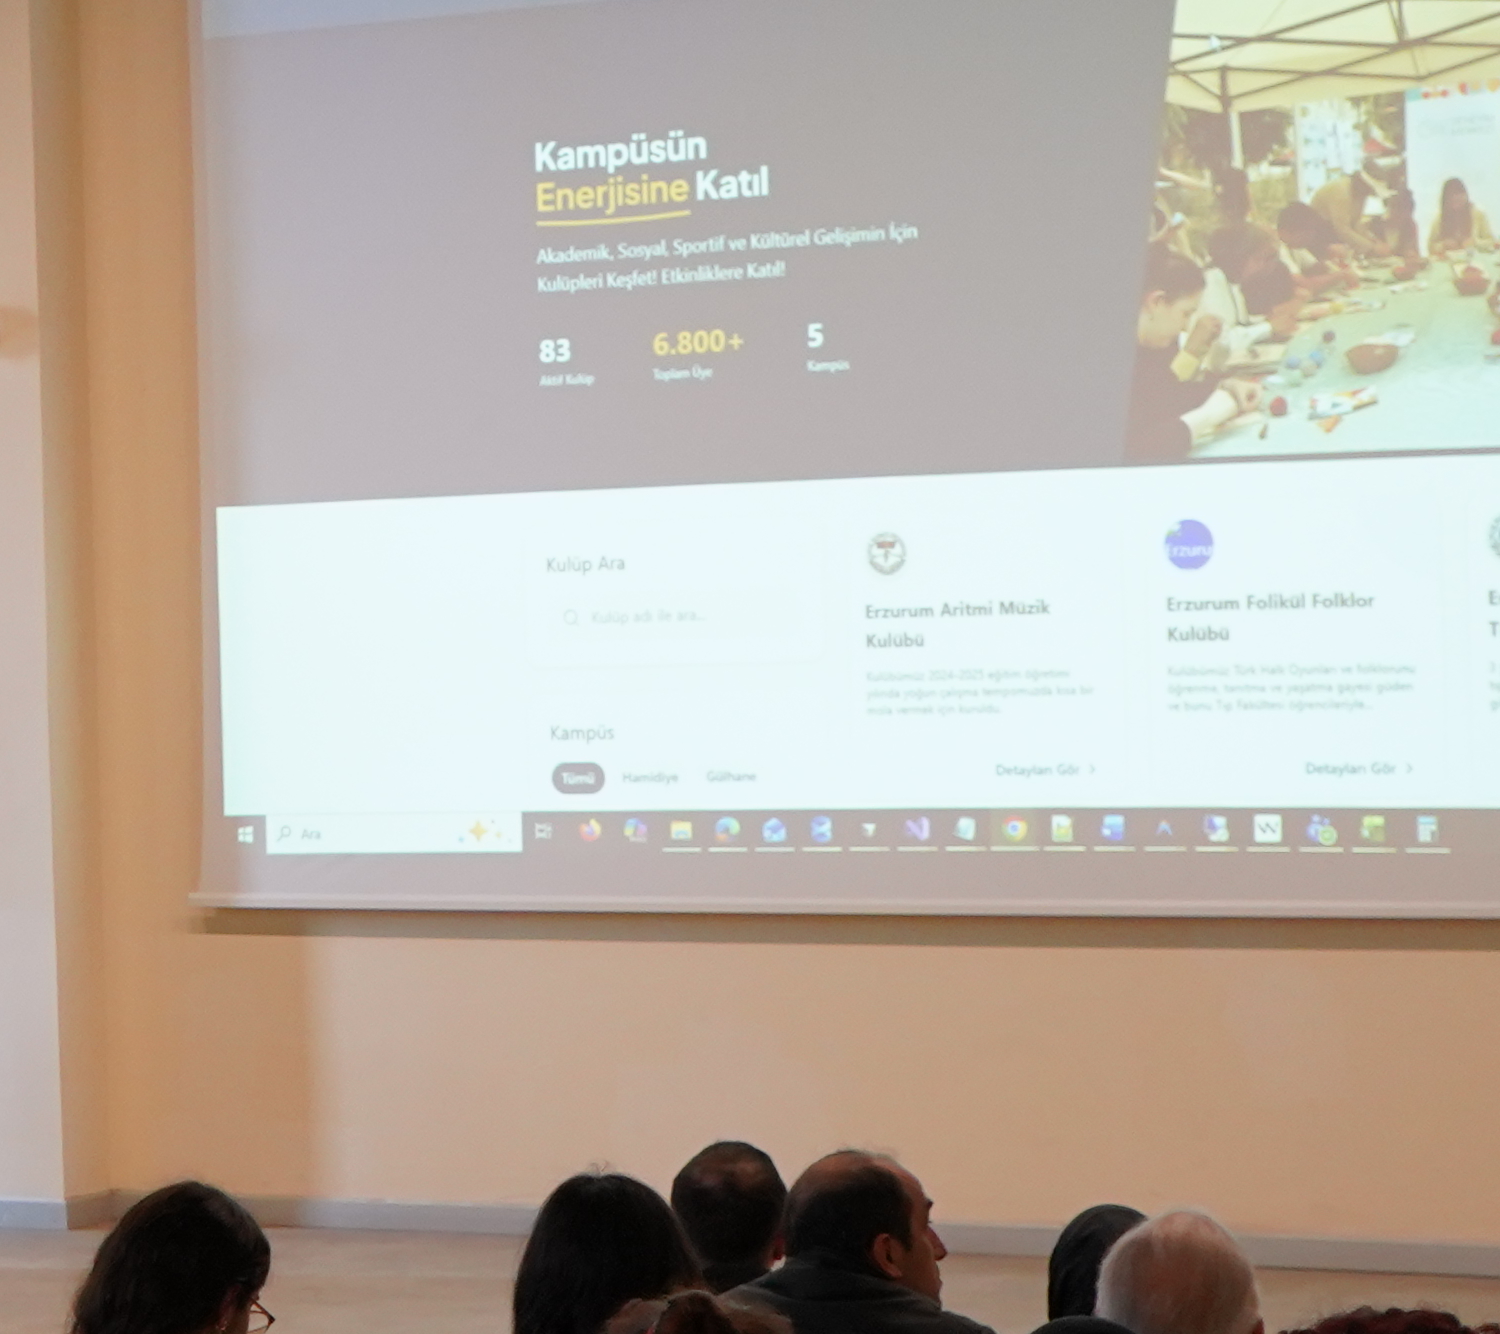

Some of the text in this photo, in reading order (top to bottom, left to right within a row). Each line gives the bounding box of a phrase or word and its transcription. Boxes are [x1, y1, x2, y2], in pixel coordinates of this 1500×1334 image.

[534, 129, 707, 172] Kampüsün
[536, 165, 769, 215] Enerjisine Katıl
[536, 222, 918, 264] Akademik, Sosyal, Sportif ve Kültürel Gelişimin İçin
[537, 260, 786, 294] Kulüpleri Keşfet! Etkinliklere Katıl!
[653, 328, 744, 356] 6.800+
[808, 323, 824, 348] 5
[539, 338, 571, 363] 83
[653, 365, 713, 382] Toplam Üye
[806, 360, 850, 373] Kampüs
[565, 373, 595, 386] Kulüp
[546, 555, 626, 575] Kulüp Ara
[865, 599, 1050, 619] Erzurum Aritmi Müzik
[1166, 592, 1374, 612] Erzurum Folikül Folklor
[591, 612, 629, 626] Kulüp
[866, 632, 925, 648] Kulübü
[1167, 626, 1230, 642] Kulübü
[550, 726, 615, 744] Kampüs
[706, 771, 757, 782] Gülhane
[1056, 763, 1079, 776] Gör
[1370, 761, 1396, 775] Gör
[562, 772, 596, 785] Tümü
[622, 772, 679, 785] Hamidiye
